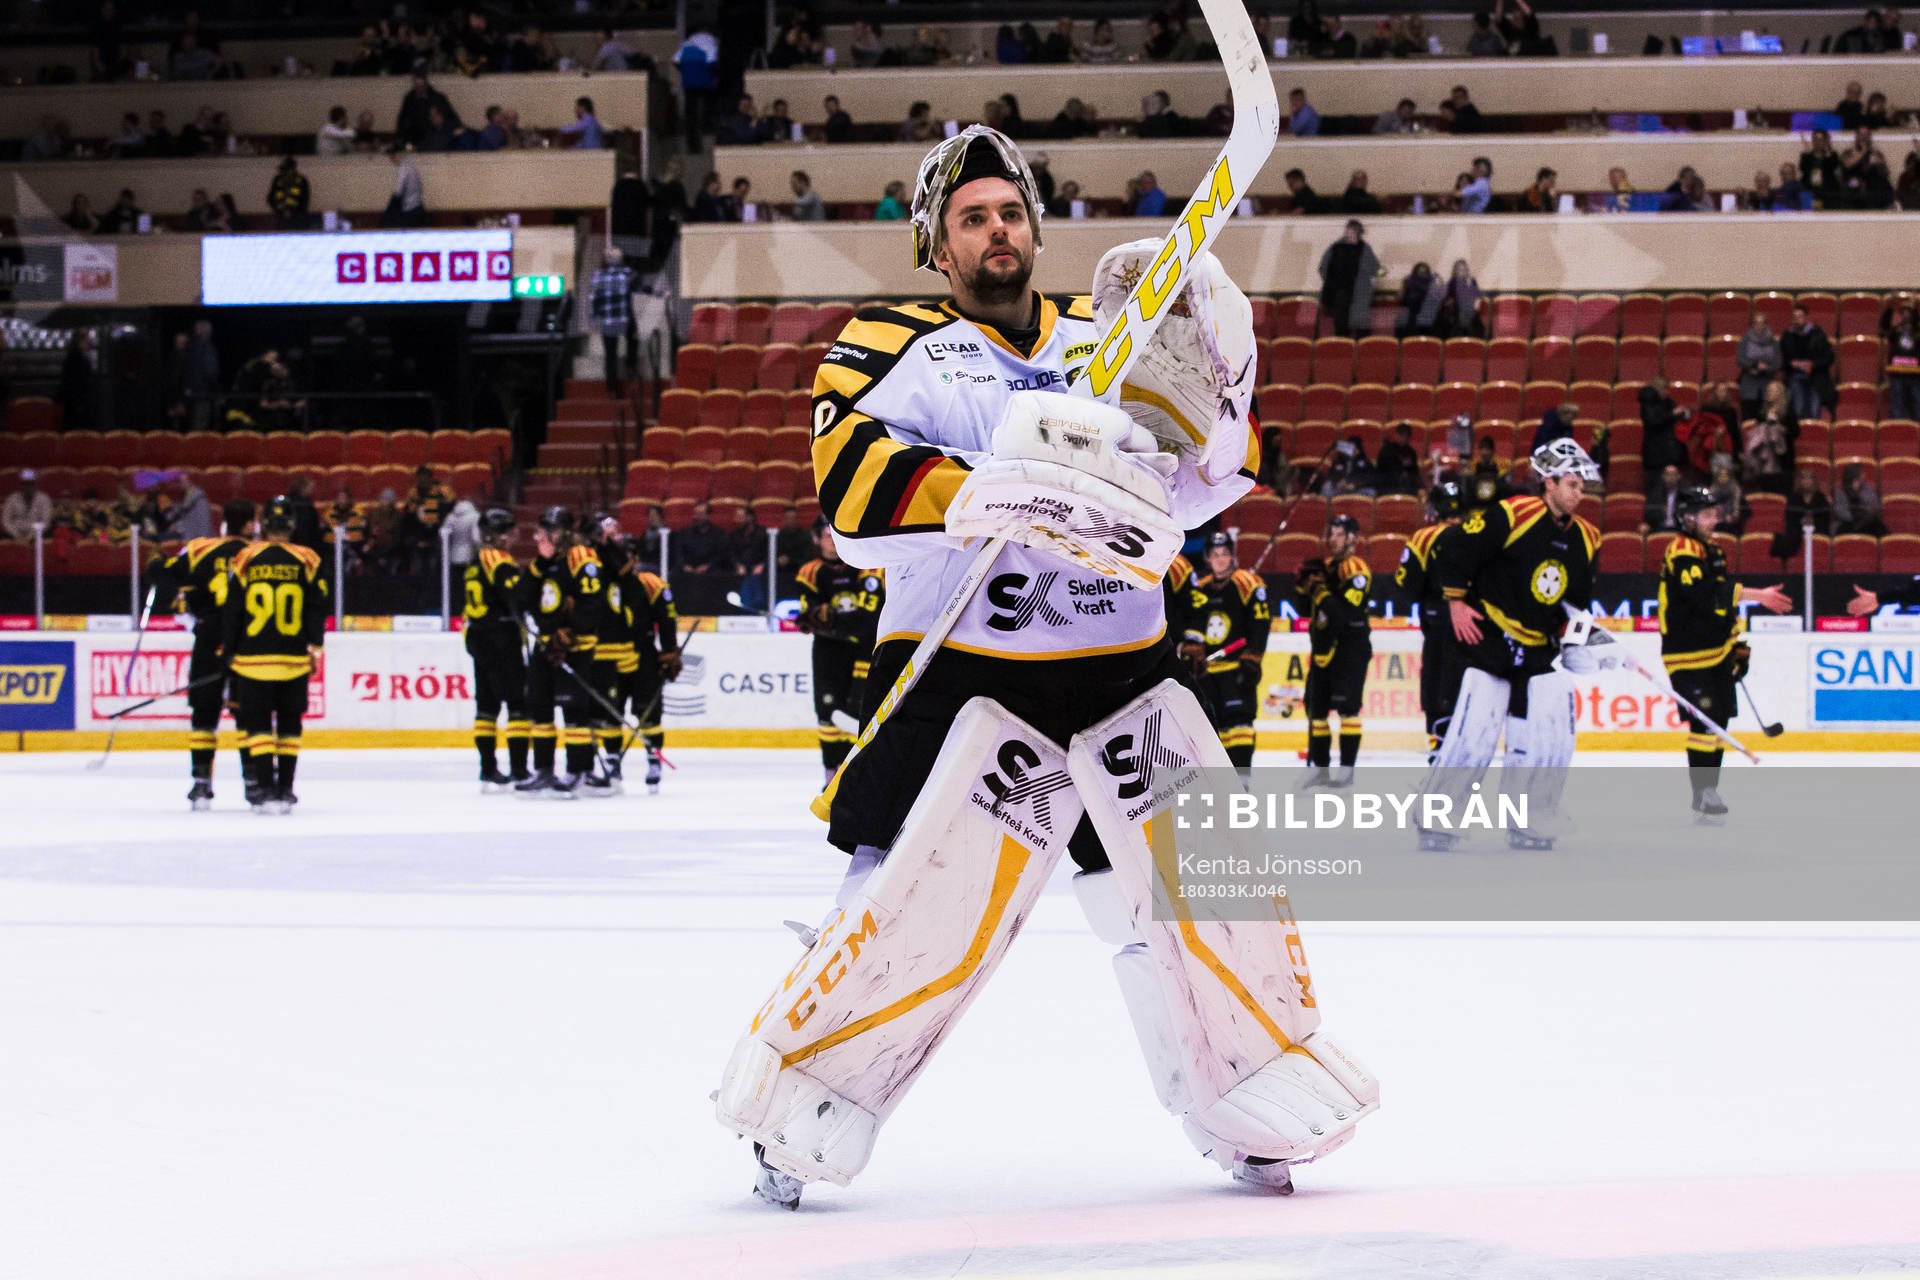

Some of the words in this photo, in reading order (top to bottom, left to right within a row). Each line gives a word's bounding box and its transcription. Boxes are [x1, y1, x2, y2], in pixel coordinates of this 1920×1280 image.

[338, 252, 512, 281] CRAMO
[1081, 155, 1235, 397] CCM
[1064, 342, 1100, 359] eng
[1031, 496, 1075, 514] Kraft
[245, 582, 304, 637] 90
[1072, 599, 1117, 615] Kraft
[0, 670, 58, 698] POT
[389, 664, 471, 700] RÖR
[718, 672, 810, 695] CASTE
[1815, 648, 1913, 685] SAN
[856, 659, 915, 751] CCM
[1126, 784, 1175, 821] Skellefteå
[1174, 769, 1199, 791] Kraft
[970, 792, 1023, 832] Skellefteå
[1022, 827, 1049, 850] Kraft
[785, 909, 879, 1032] CCM
